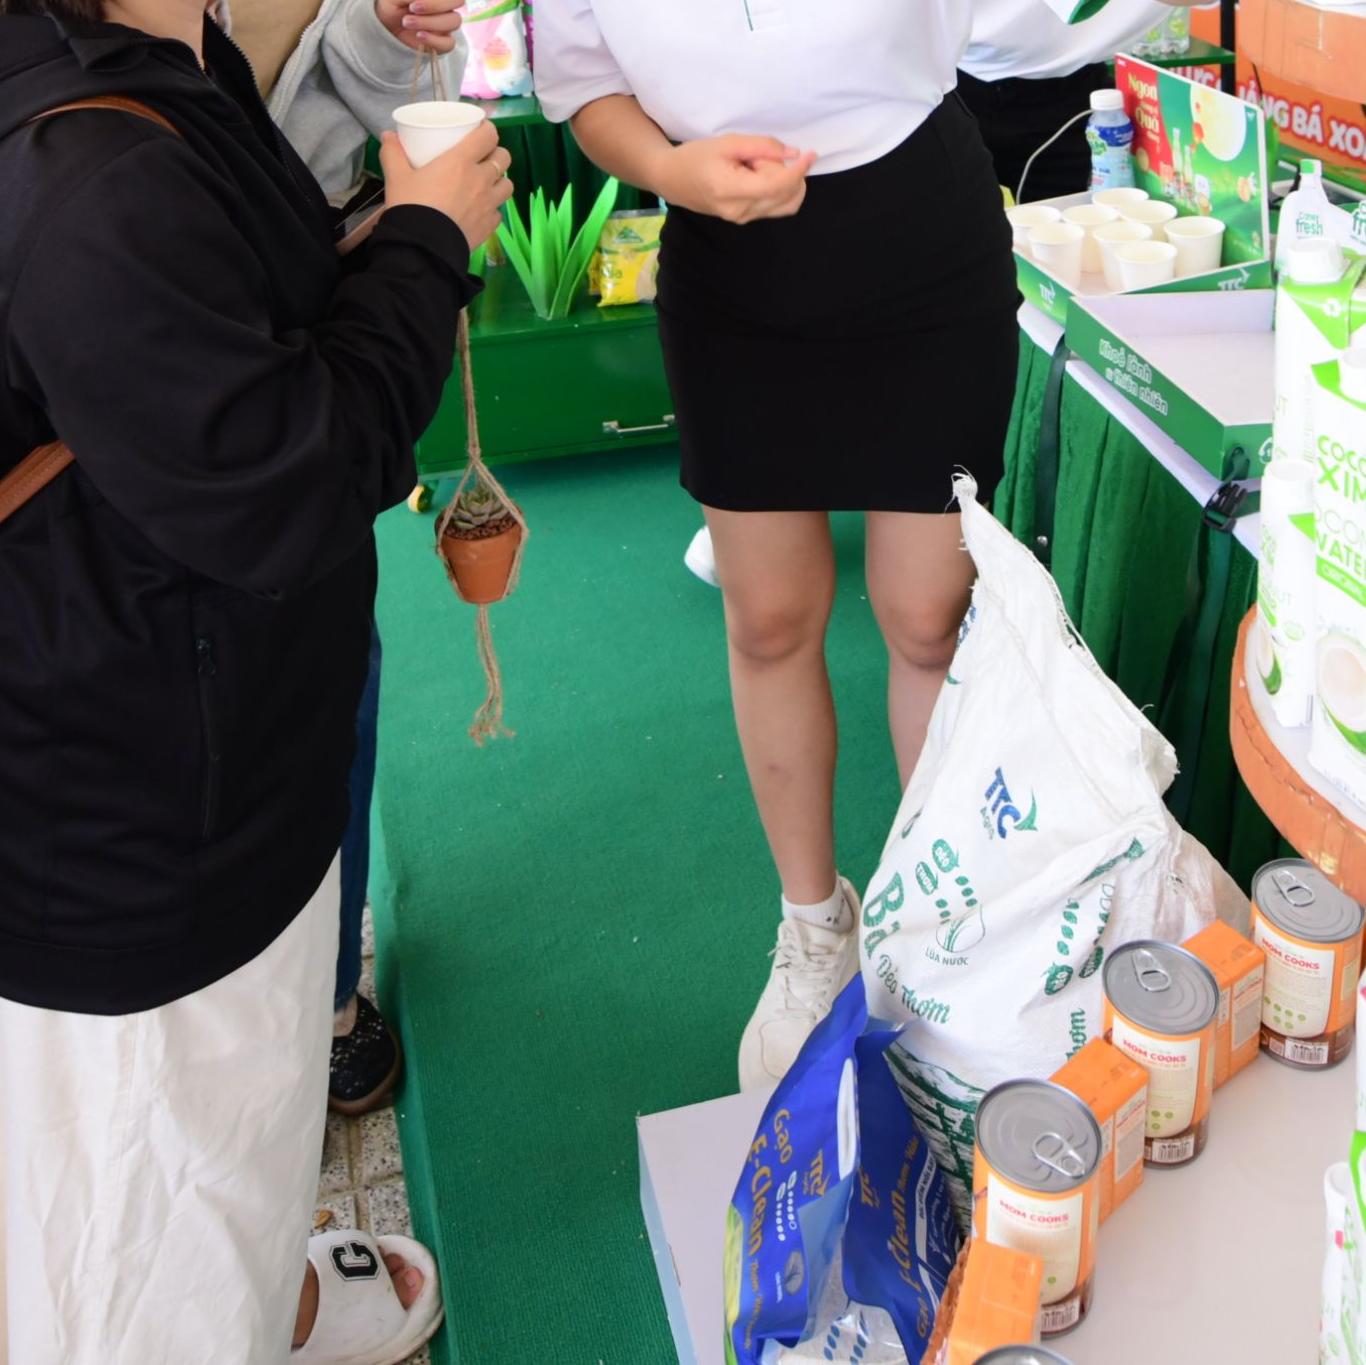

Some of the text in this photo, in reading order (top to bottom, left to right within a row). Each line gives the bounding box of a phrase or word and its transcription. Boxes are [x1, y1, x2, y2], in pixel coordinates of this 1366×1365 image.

[1293, 100, 1324, 143] BÁ
[984, 766, 1022, 840] TTC
[1261, 938, 1320, 971] MOM COOKS
[1123, 1038, 1187, 1064] MOM COOKS
[999, 1199, 1070, 1225] MOM COOKS
